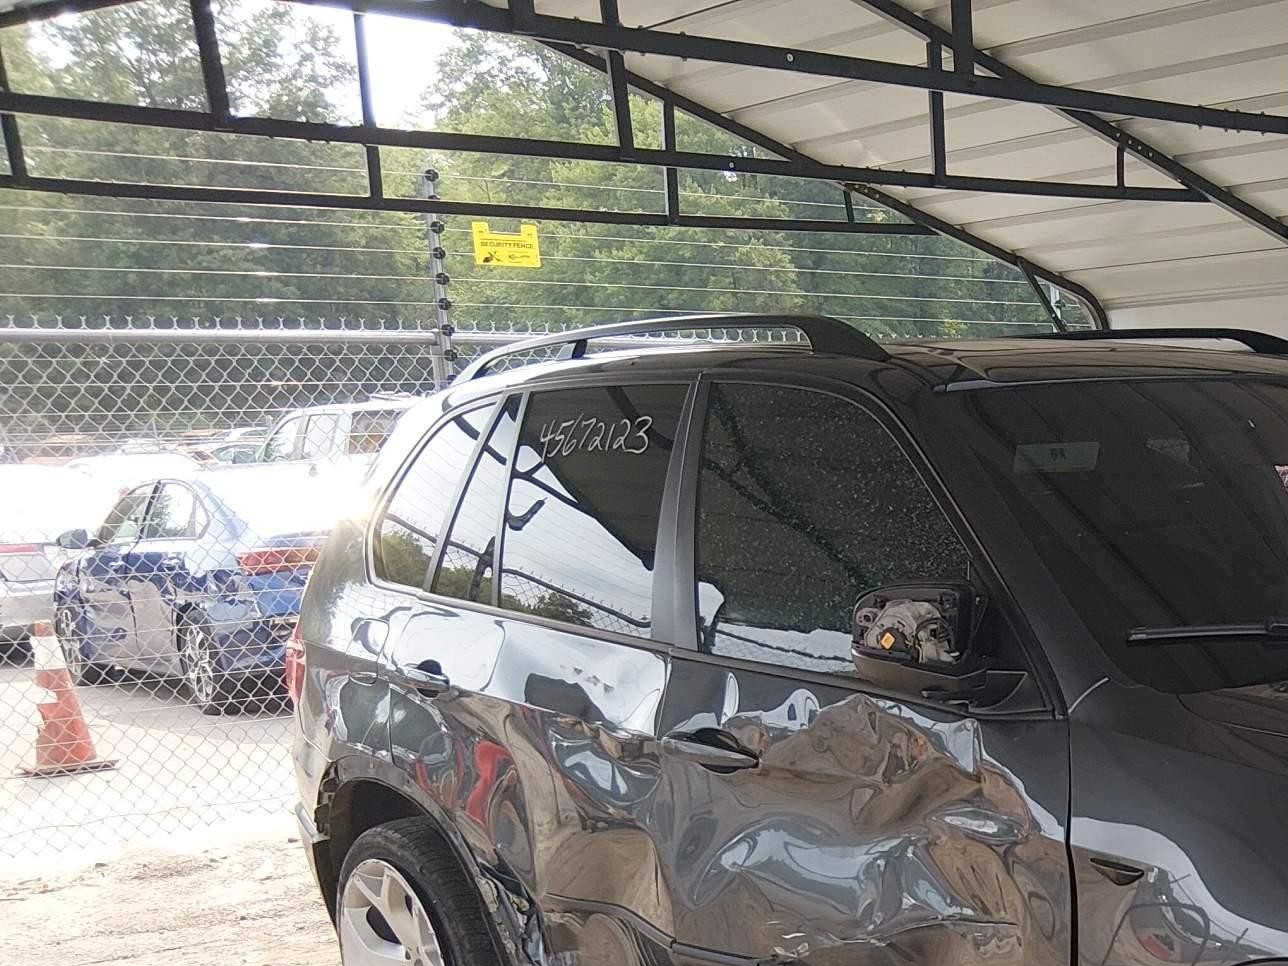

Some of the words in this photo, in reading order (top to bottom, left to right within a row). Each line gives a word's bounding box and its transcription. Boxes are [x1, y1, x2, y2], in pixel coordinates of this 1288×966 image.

[480, 241, 512, 249] SECURITY
[512, 242, 534, 250] FENCE
[540, 412, 653, 464] 45672123
